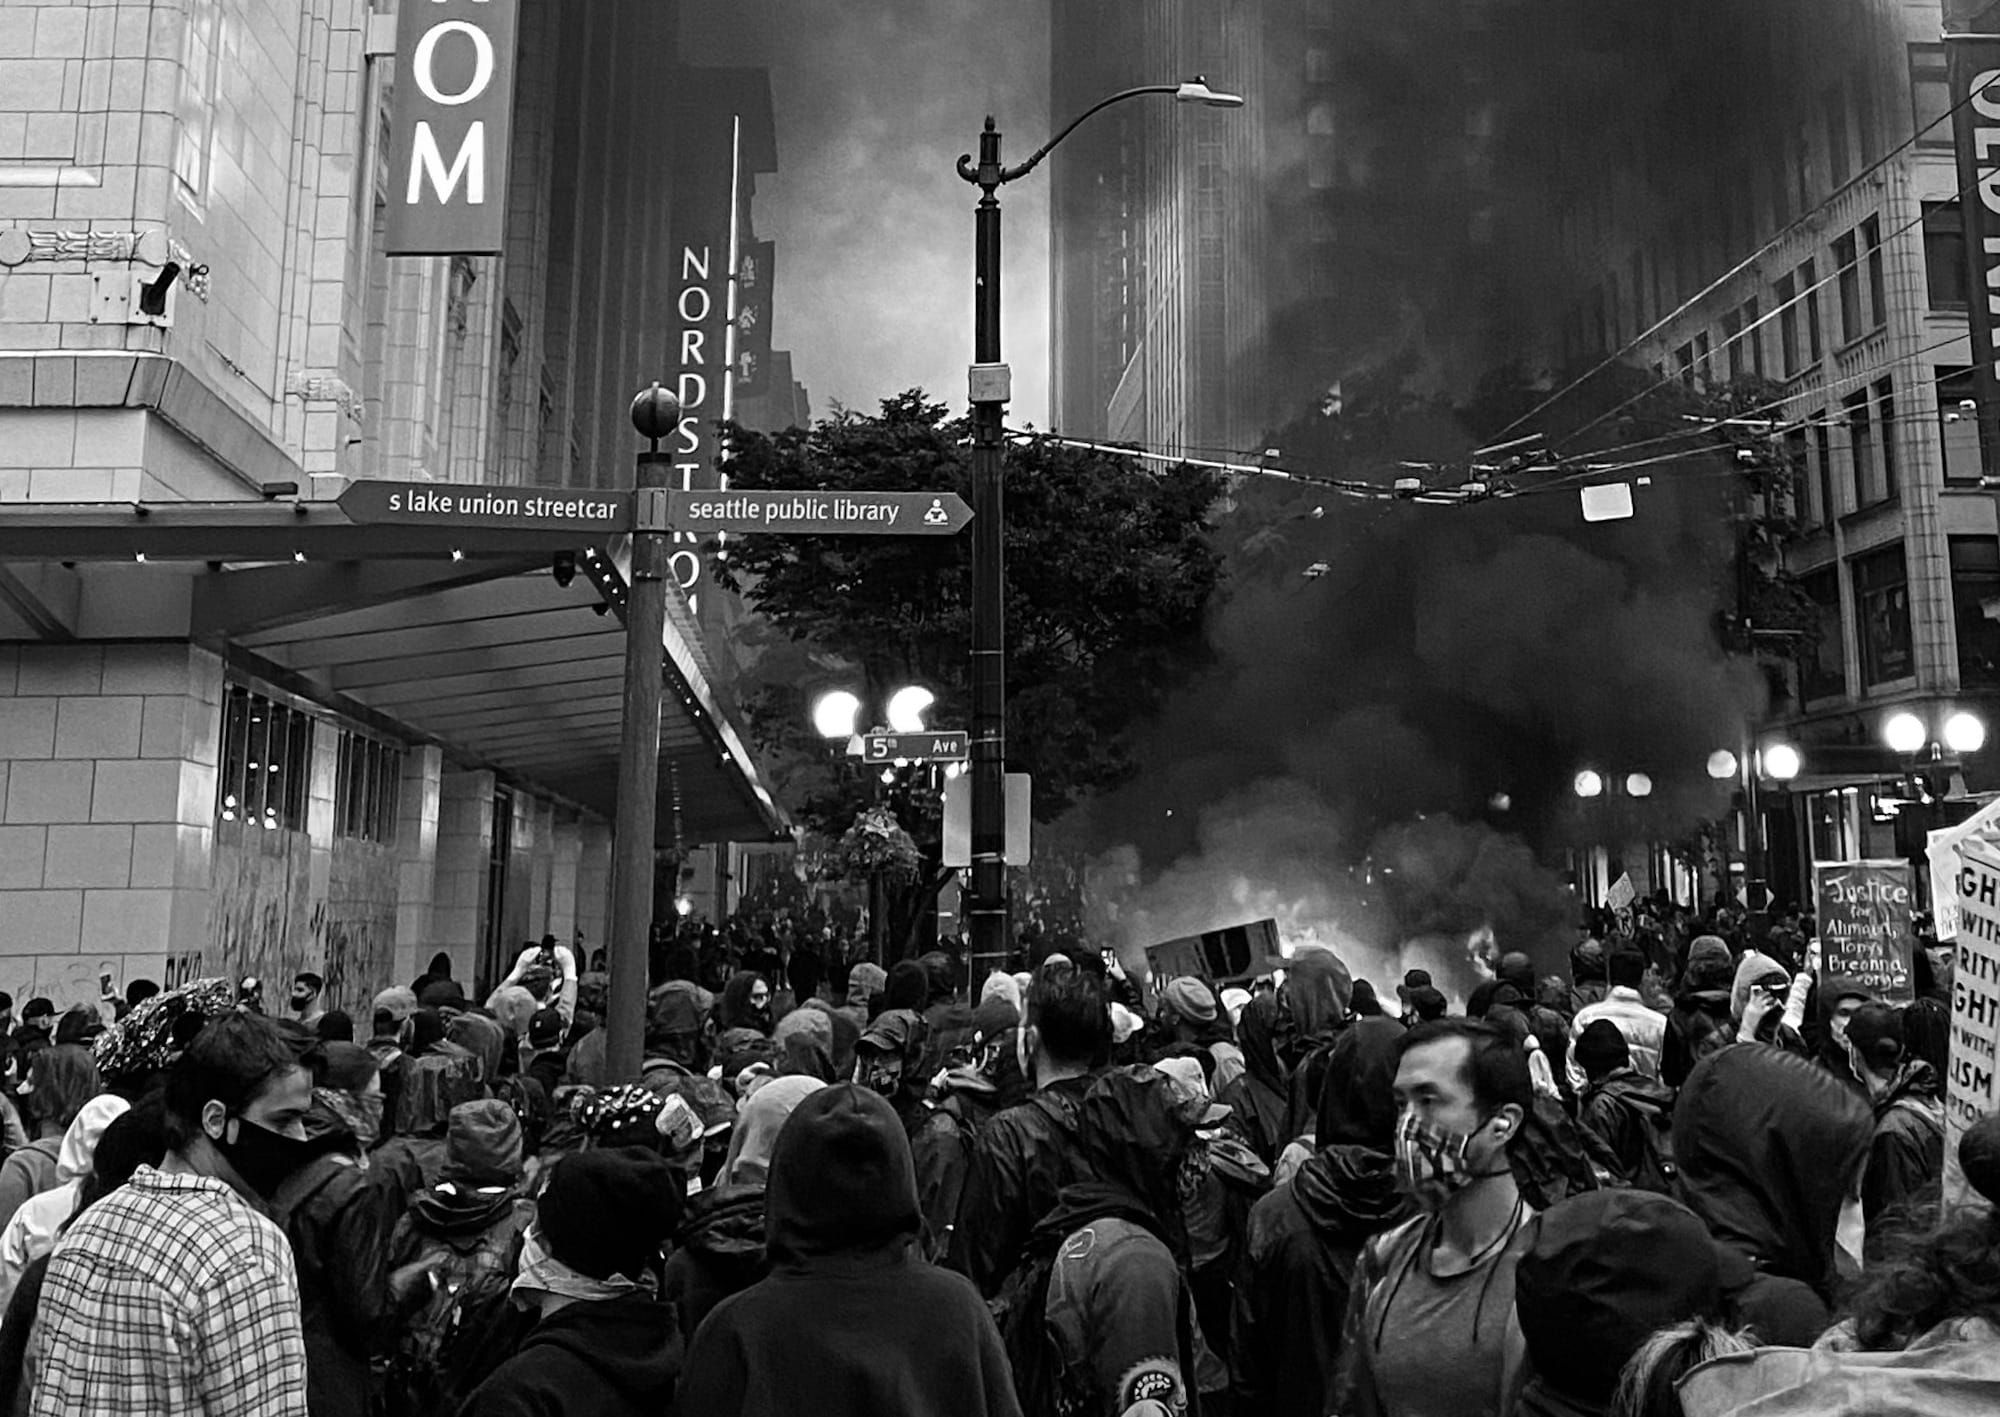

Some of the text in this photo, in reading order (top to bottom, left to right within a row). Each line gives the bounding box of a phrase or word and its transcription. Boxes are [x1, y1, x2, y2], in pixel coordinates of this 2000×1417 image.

[389, 489, 618, 520] s lake union streetcar
[688, 497, 900, 526] seattle public library
[932, 739, 958, 753] Ave
[1825, 873, 1908, 904] Justice
